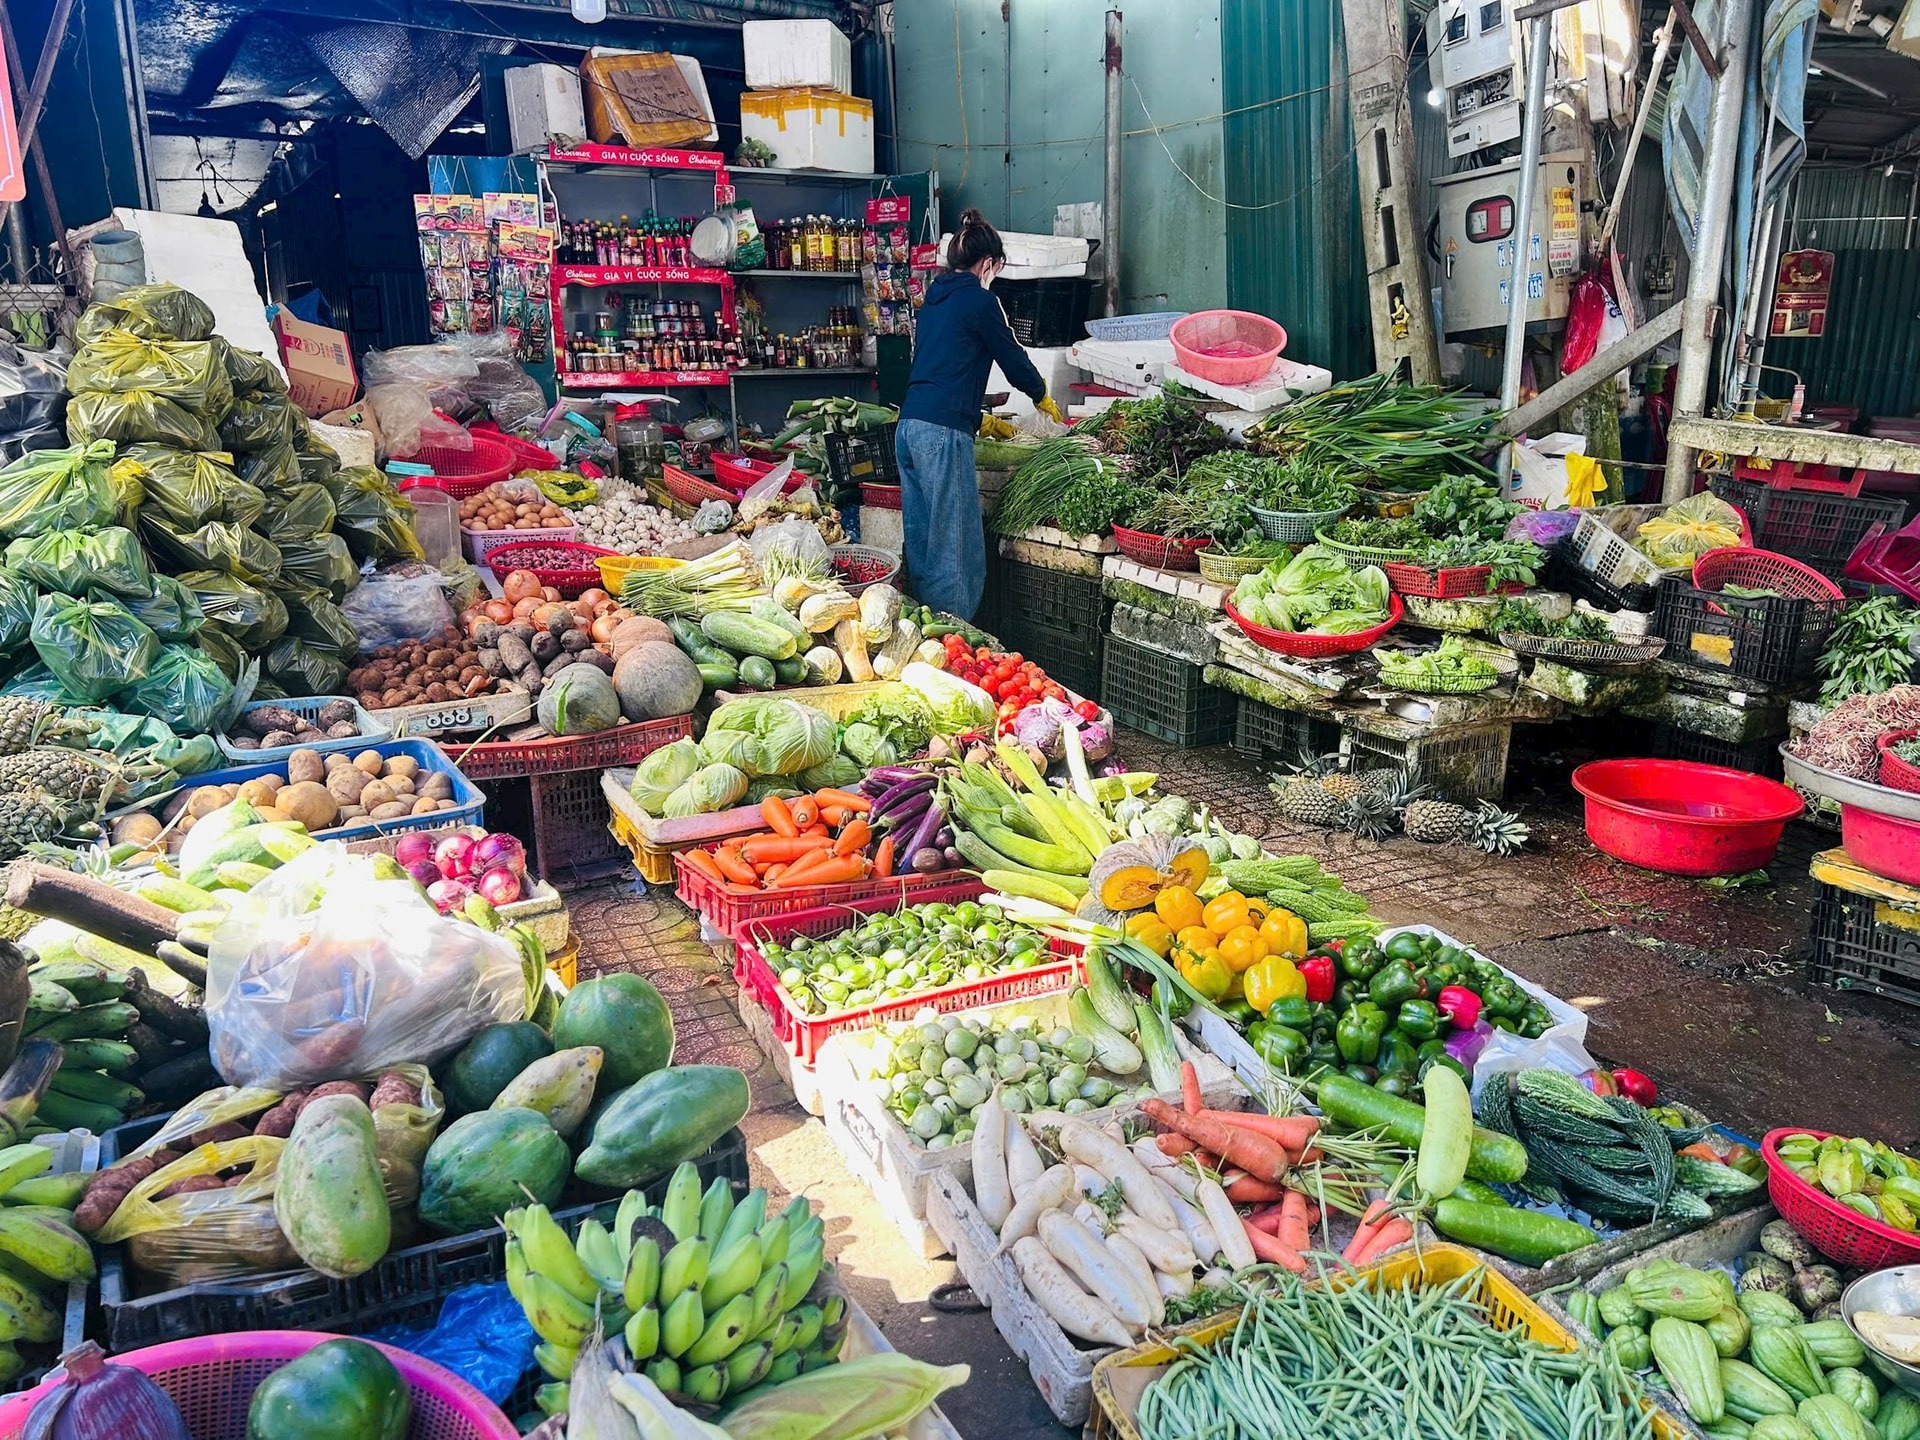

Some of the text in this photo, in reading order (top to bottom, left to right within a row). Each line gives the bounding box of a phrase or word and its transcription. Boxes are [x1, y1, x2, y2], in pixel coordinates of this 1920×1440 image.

[601, 151, 617, 160] GIA
[618, 152, 628, 163] VỊ
[629, 151, 654, 165] CUỘC
[655, 151, 679, 164] SỐNG
[688, 153, 722, 166] Cholimex
[565, 266, 689, 281] Cholimex GIA VỊ CUỘC SỐNG
[677, 372, 711, 383] Cholimex
